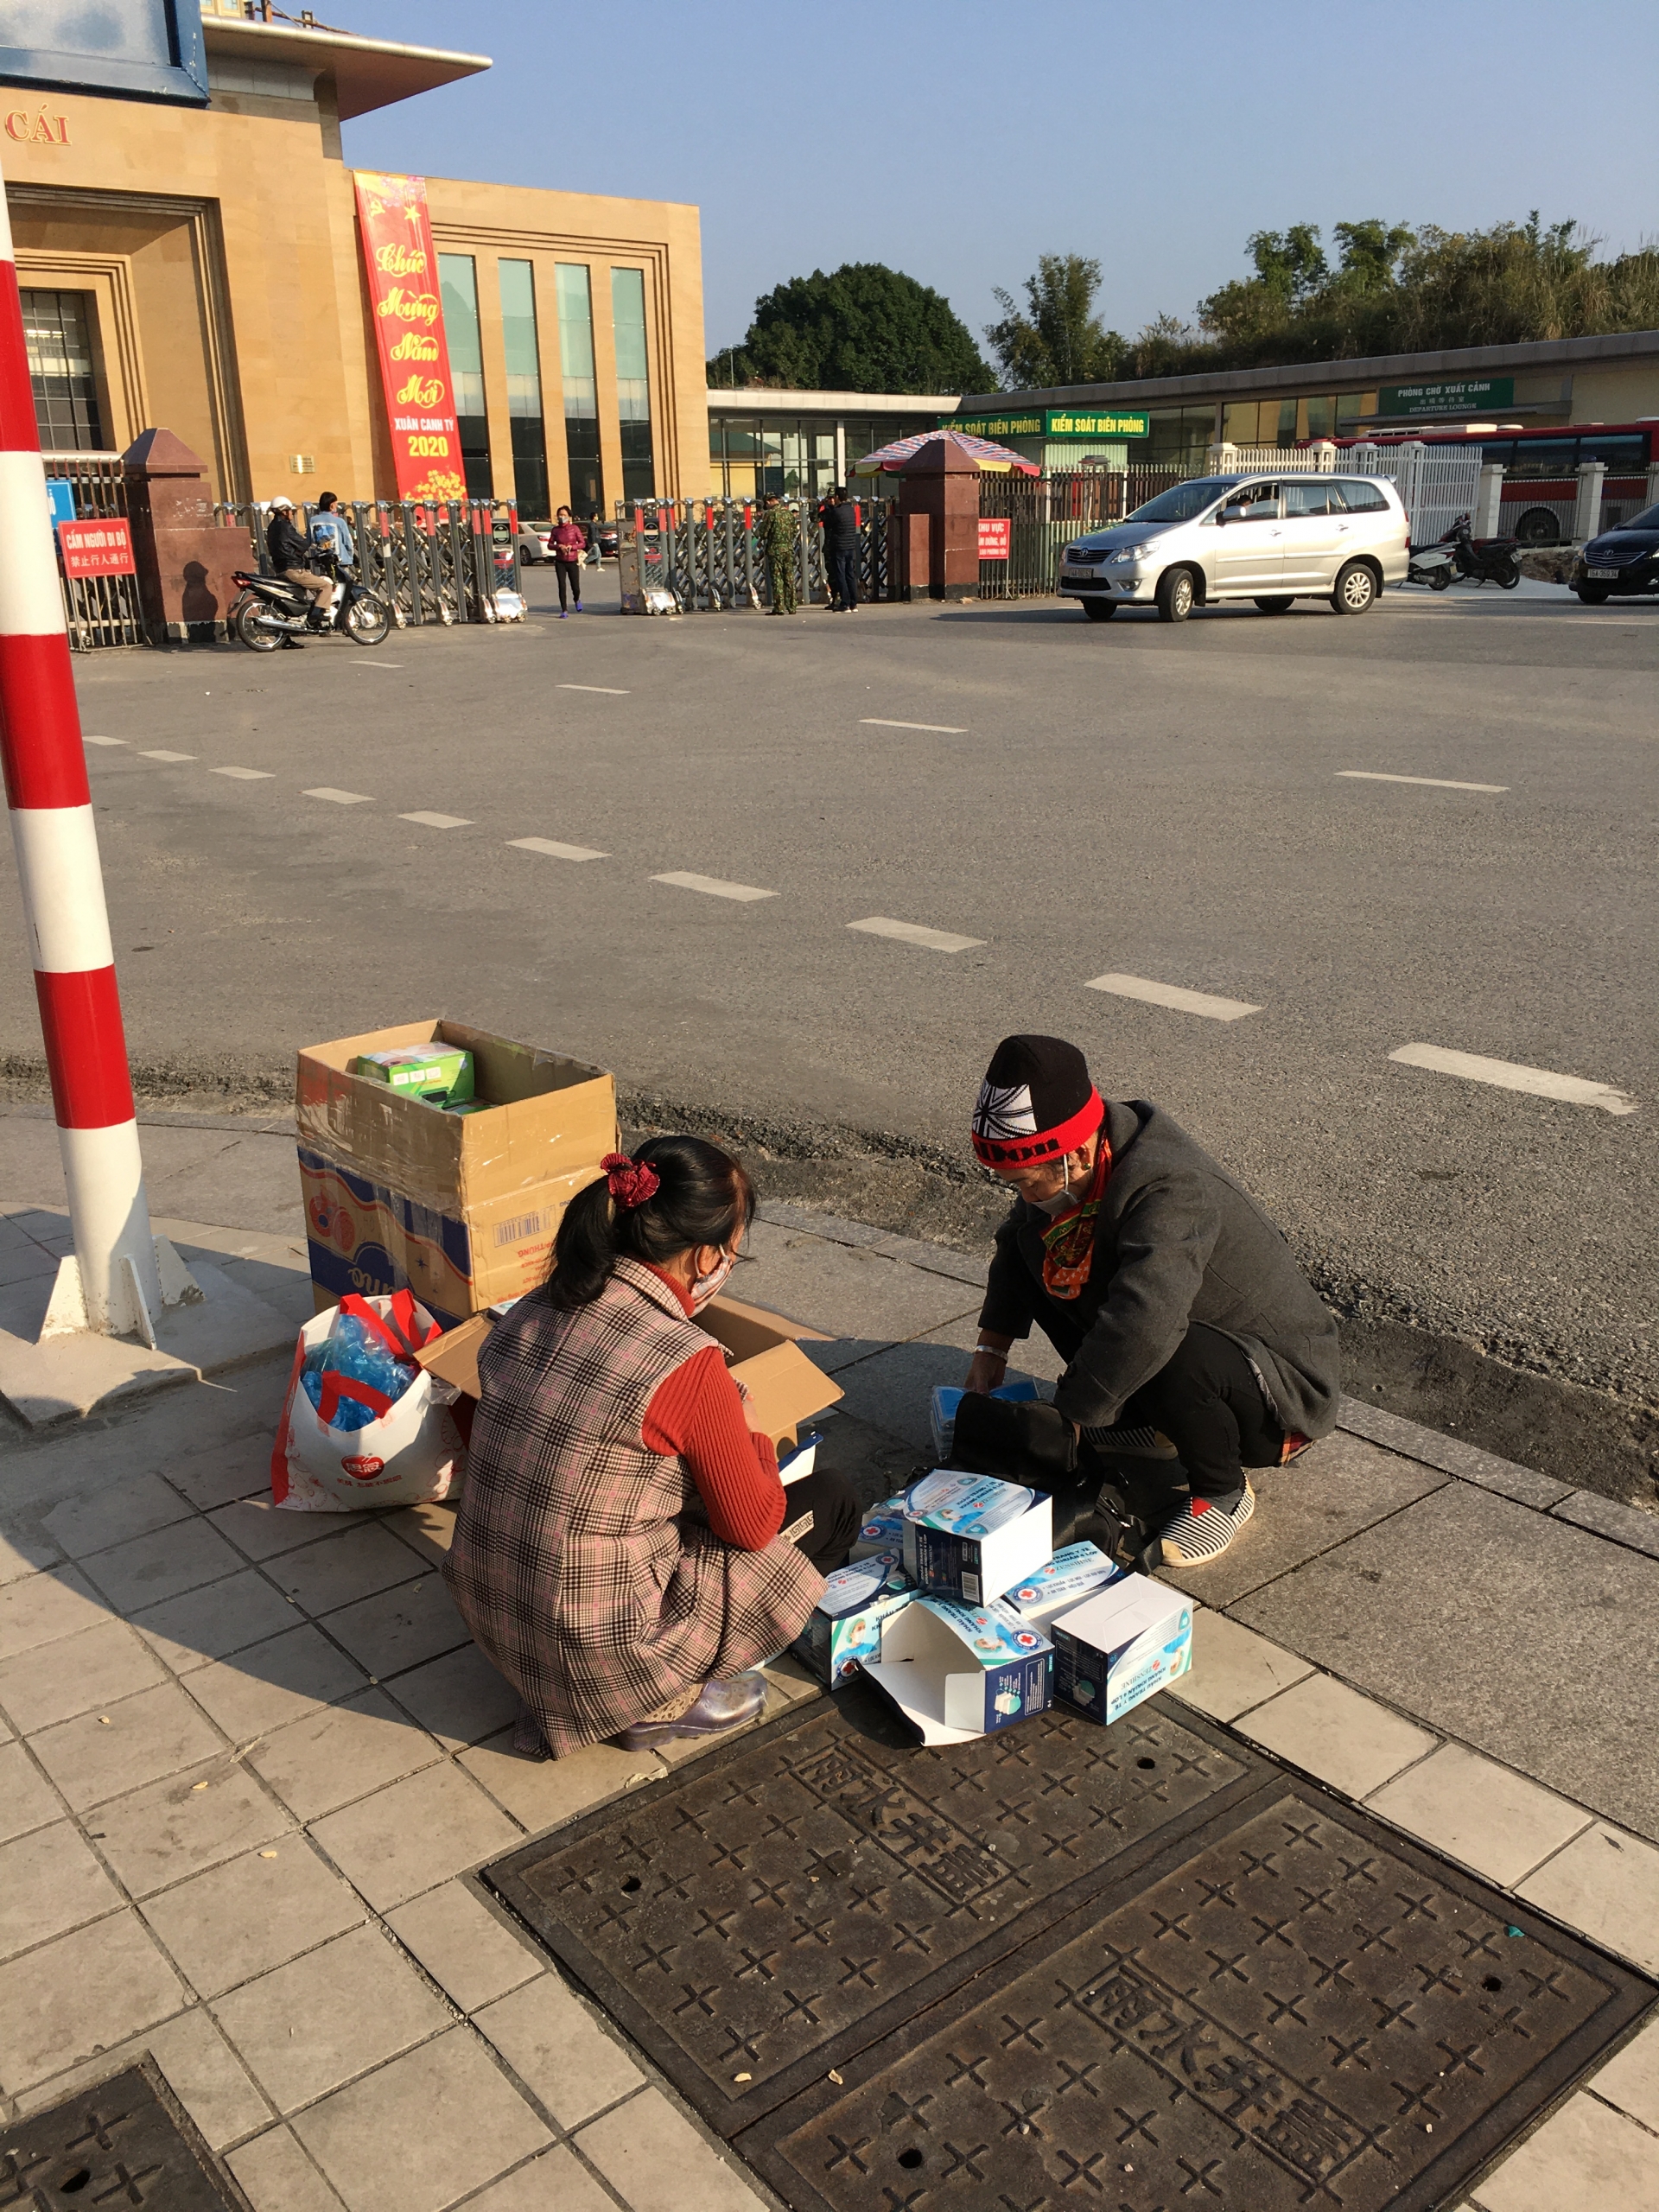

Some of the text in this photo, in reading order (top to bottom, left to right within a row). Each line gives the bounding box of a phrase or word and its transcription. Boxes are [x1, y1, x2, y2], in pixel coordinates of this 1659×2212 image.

[6, 103, 72, 145] CÁI
[376, 243, 427, 277] Chúc
[377, 286, 439, 326] Mừng
[391, 332, 439, 361] Năm
[397, 374, 445, 409] Mới
[1409, 404, 1448, 413] DEPARTURE
[394, 416, 419, 431] XUÂN
[421, 418, 443, 431] CANH
[965, 420, 987, 435] SOÁT
[988, 419, 1008, 435] BIÊN
[1011, 417, 1041, 434] PHÒNG
[1052, 414, 1144, 433] KIỂM SOÁT BIÊN PHÒNG
[408, 435, 448, 457] 2020
[66, 528, 127, 550] CẤM NGƯỜI ĐI BỘ
[71, 552, 129, 568] 禁止行人通行
[798, 1744, 1002, 1901] 雨水井盖
[1084, 1964, 1353, 2179] 雨水井盖
